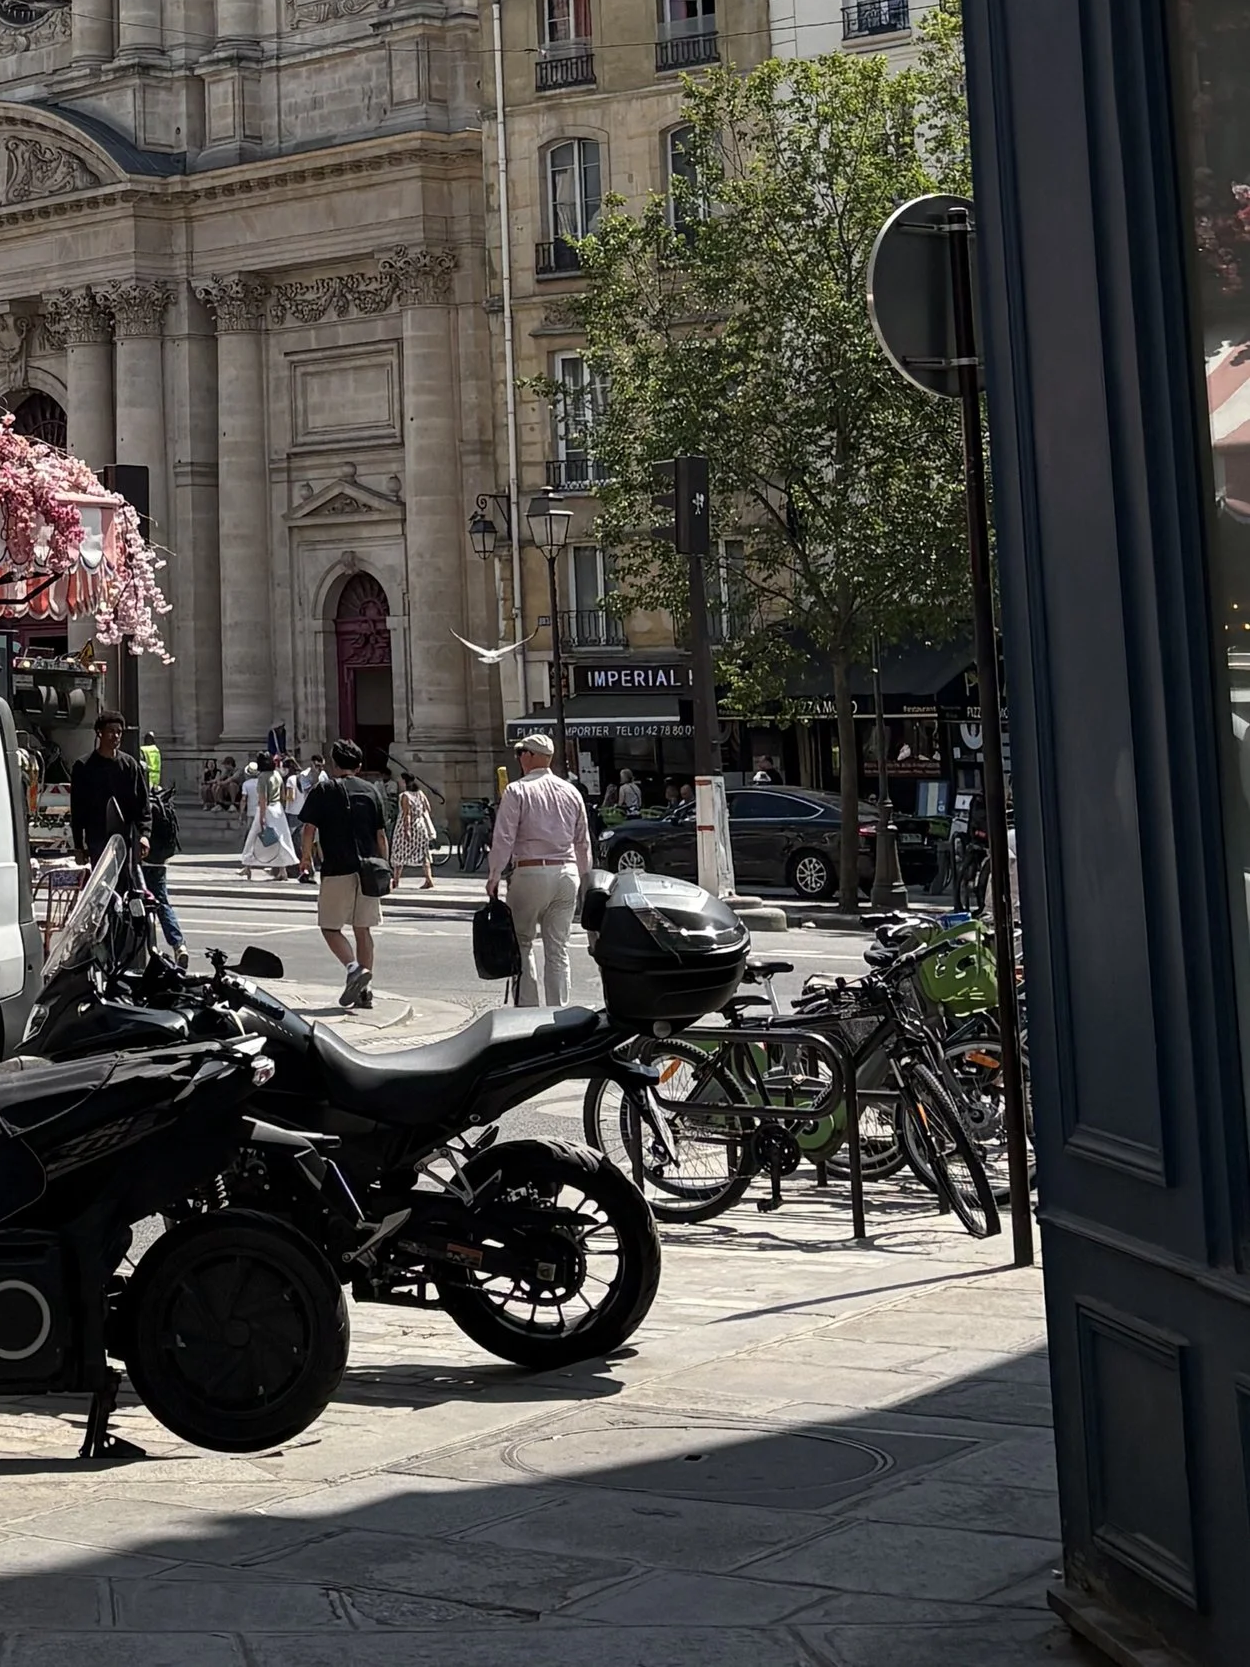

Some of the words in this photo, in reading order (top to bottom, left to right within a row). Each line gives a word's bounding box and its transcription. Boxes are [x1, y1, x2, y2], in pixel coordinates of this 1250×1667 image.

[587, 669, 682, 687] IMPERIAL
[967, 705, 982, 718] PIZZ
[564, 726, 609, 737] MPORTER
